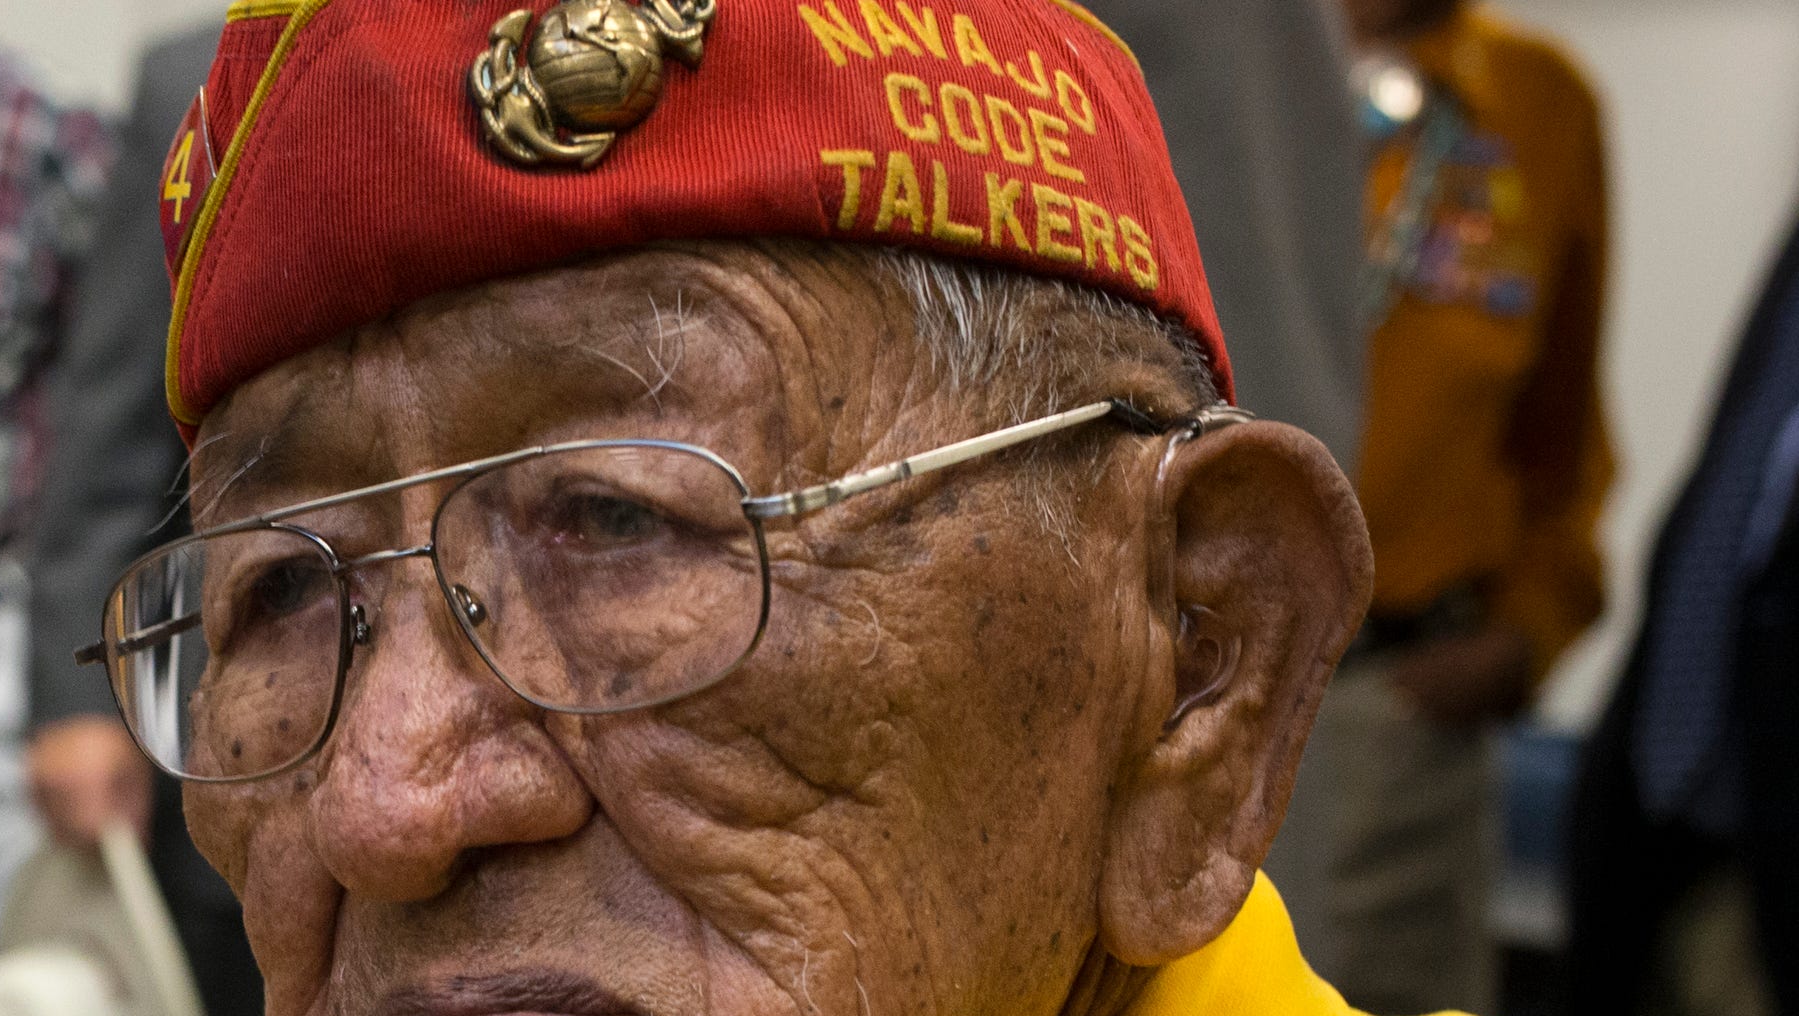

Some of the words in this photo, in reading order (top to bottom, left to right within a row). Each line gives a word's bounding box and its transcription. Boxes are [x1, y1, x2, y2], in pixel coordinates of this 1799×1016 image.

[798, 0, 1097, 136] NAVAJO
[884, 72, 1086, 184] CODE
[163, 128, 195, 224] 4
[820, 149, 1159, 290] TALKERS
